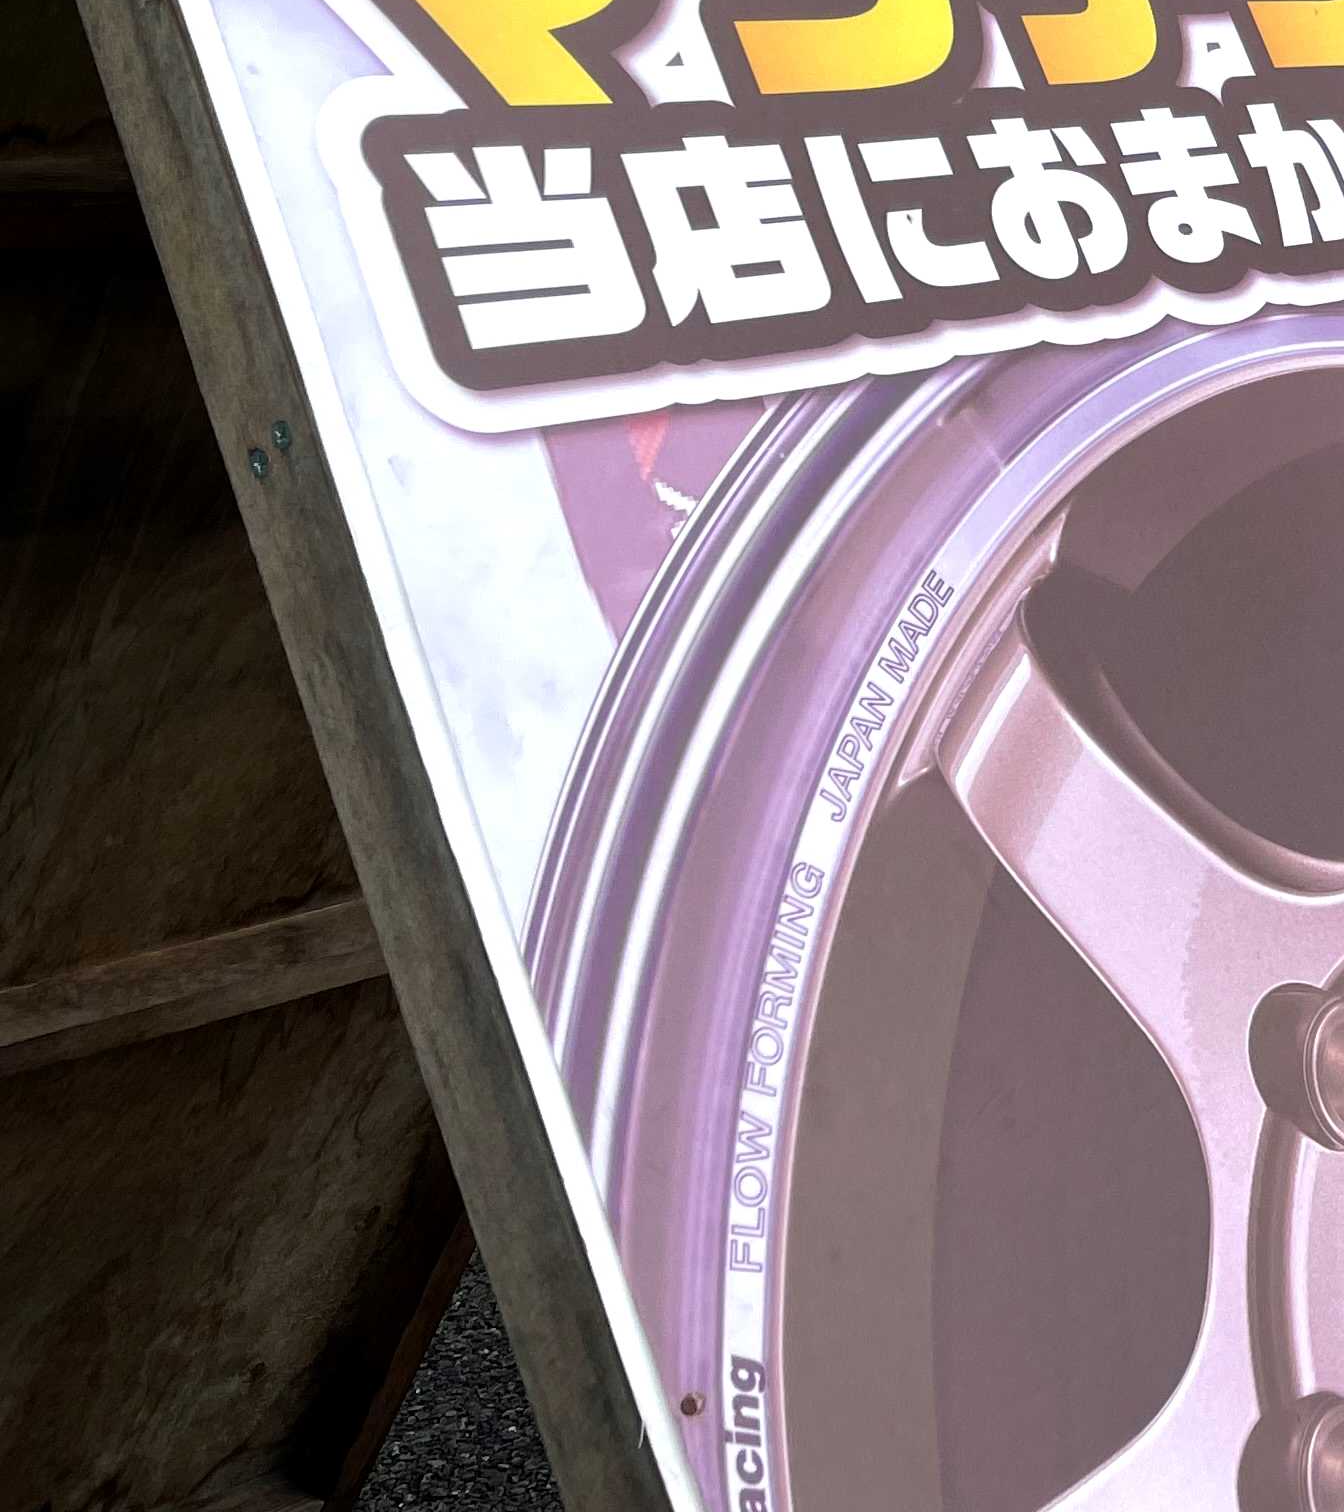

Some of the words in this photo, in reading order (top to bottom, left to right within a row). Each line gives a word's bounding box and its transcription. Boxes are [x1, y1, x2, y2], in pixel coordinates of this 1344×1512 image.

[878, 568, 957, 694] MADE
[819, 684, 895, 823] JAPAN
[744, 860, 827, 1094] FORMING
[729, 1110, 774, 1274] FLOW
